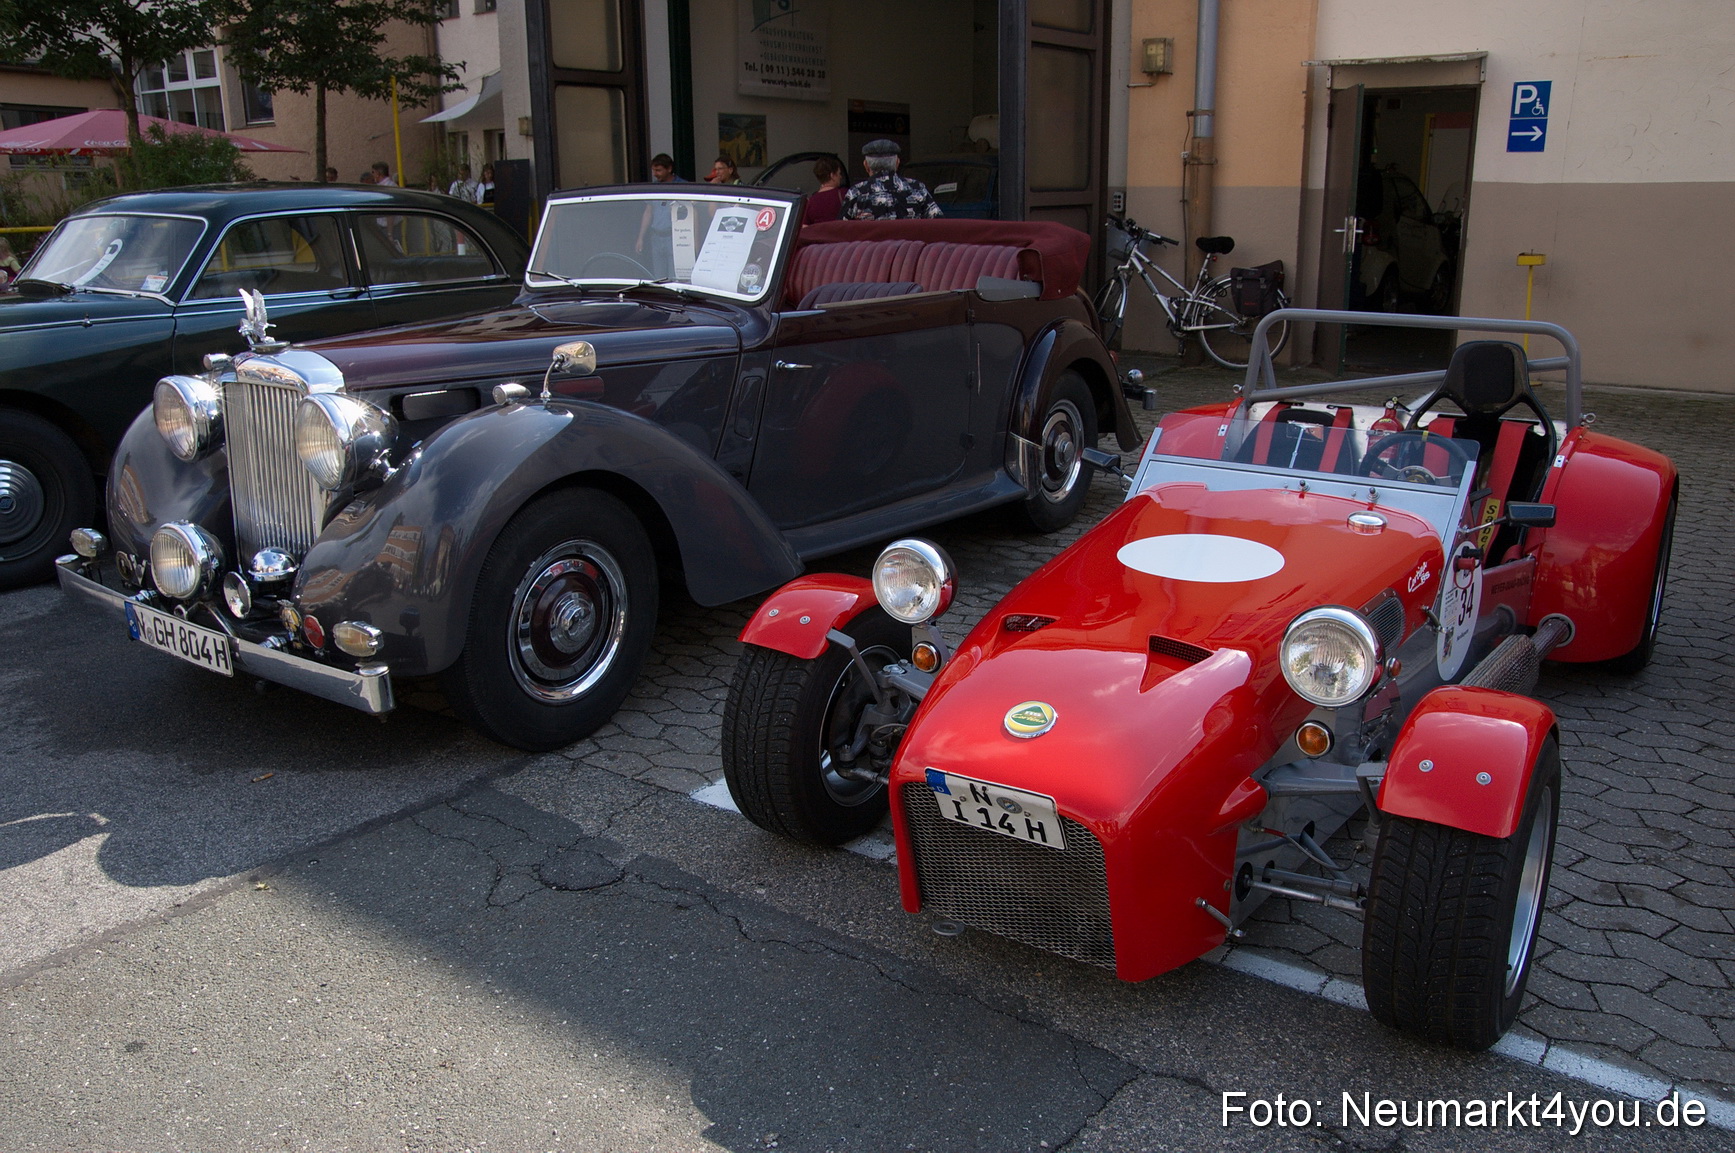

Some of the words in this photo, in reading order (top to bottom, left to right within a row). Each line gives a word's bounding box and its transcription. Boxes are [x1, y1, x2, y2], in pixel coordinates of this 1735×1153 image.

[744, 62, 758, 72] Tel.
[1514, 85, 1538, 114] P
[759, 212, 770, 226] A
[1458, 582, 1475, 626] 34
[135, 609, 147, 639] N
[153, 616, 177, 651] GH
[1012, 713, 1047, 724] Cortina
[970, 783, 993, 806] N
